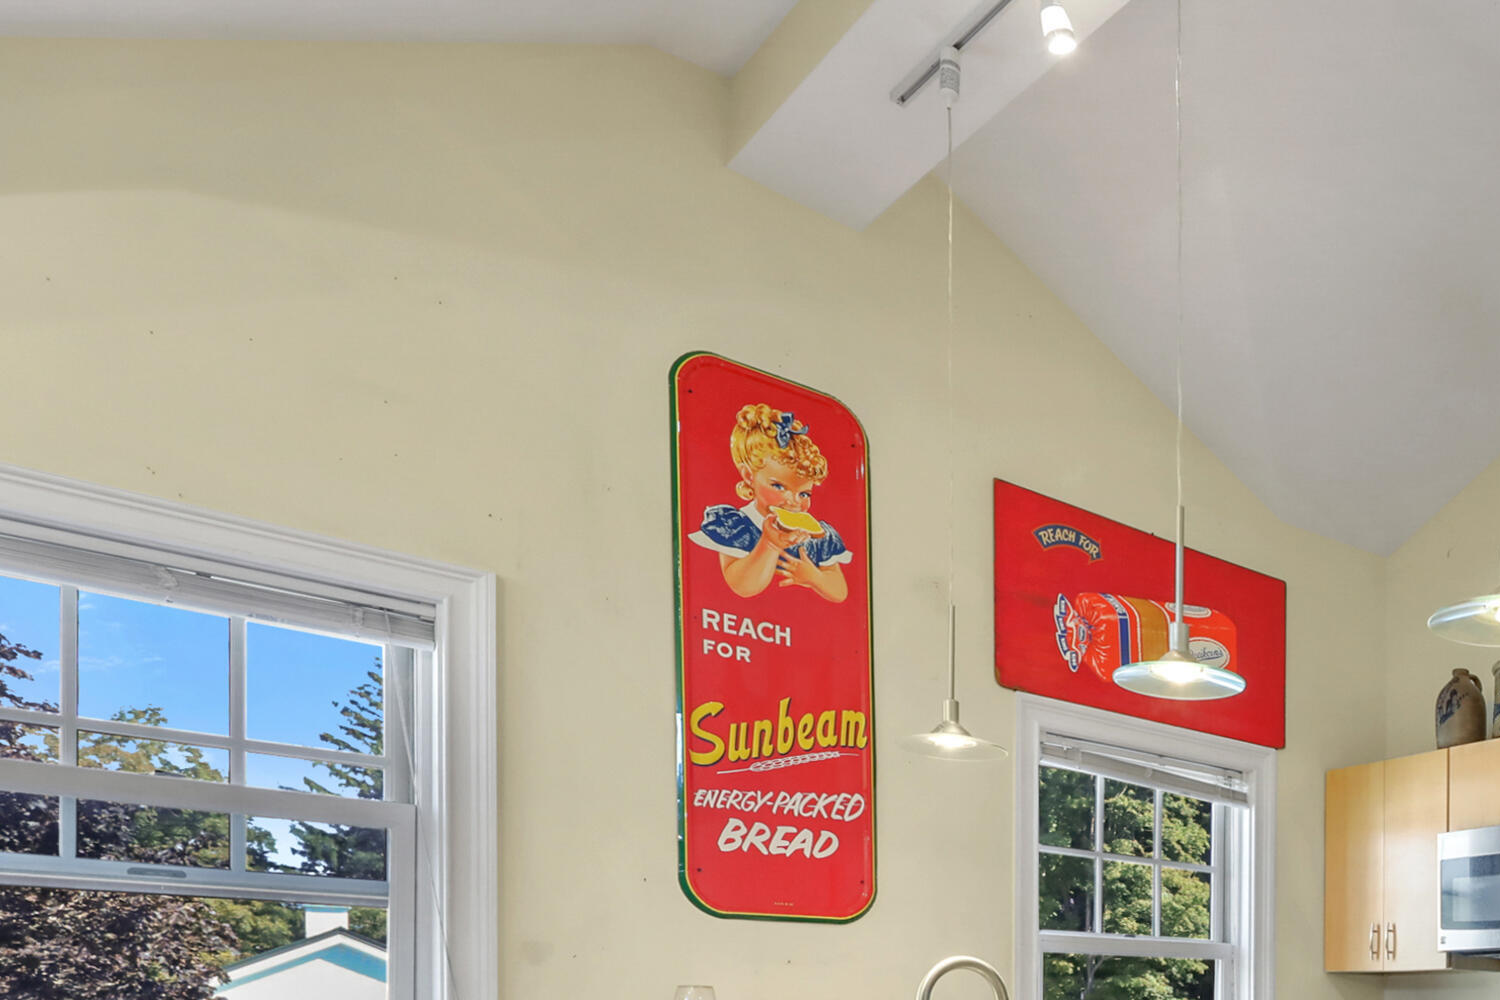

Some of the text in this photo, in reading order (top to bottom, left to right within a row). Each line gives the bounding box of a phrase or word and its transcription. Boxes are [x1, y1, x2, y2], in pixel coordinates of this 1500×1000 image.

[1038, 528, 1099, 559] REACH FOR
[702, 608, 791, 647] REACH
[703, 639, 752, 663] FOR
[689, 697, 868, 767] Sunbeam
[693, 789, 866, 823] ENERGY-PACKED
[717, 818, 840, 859] BREAD
